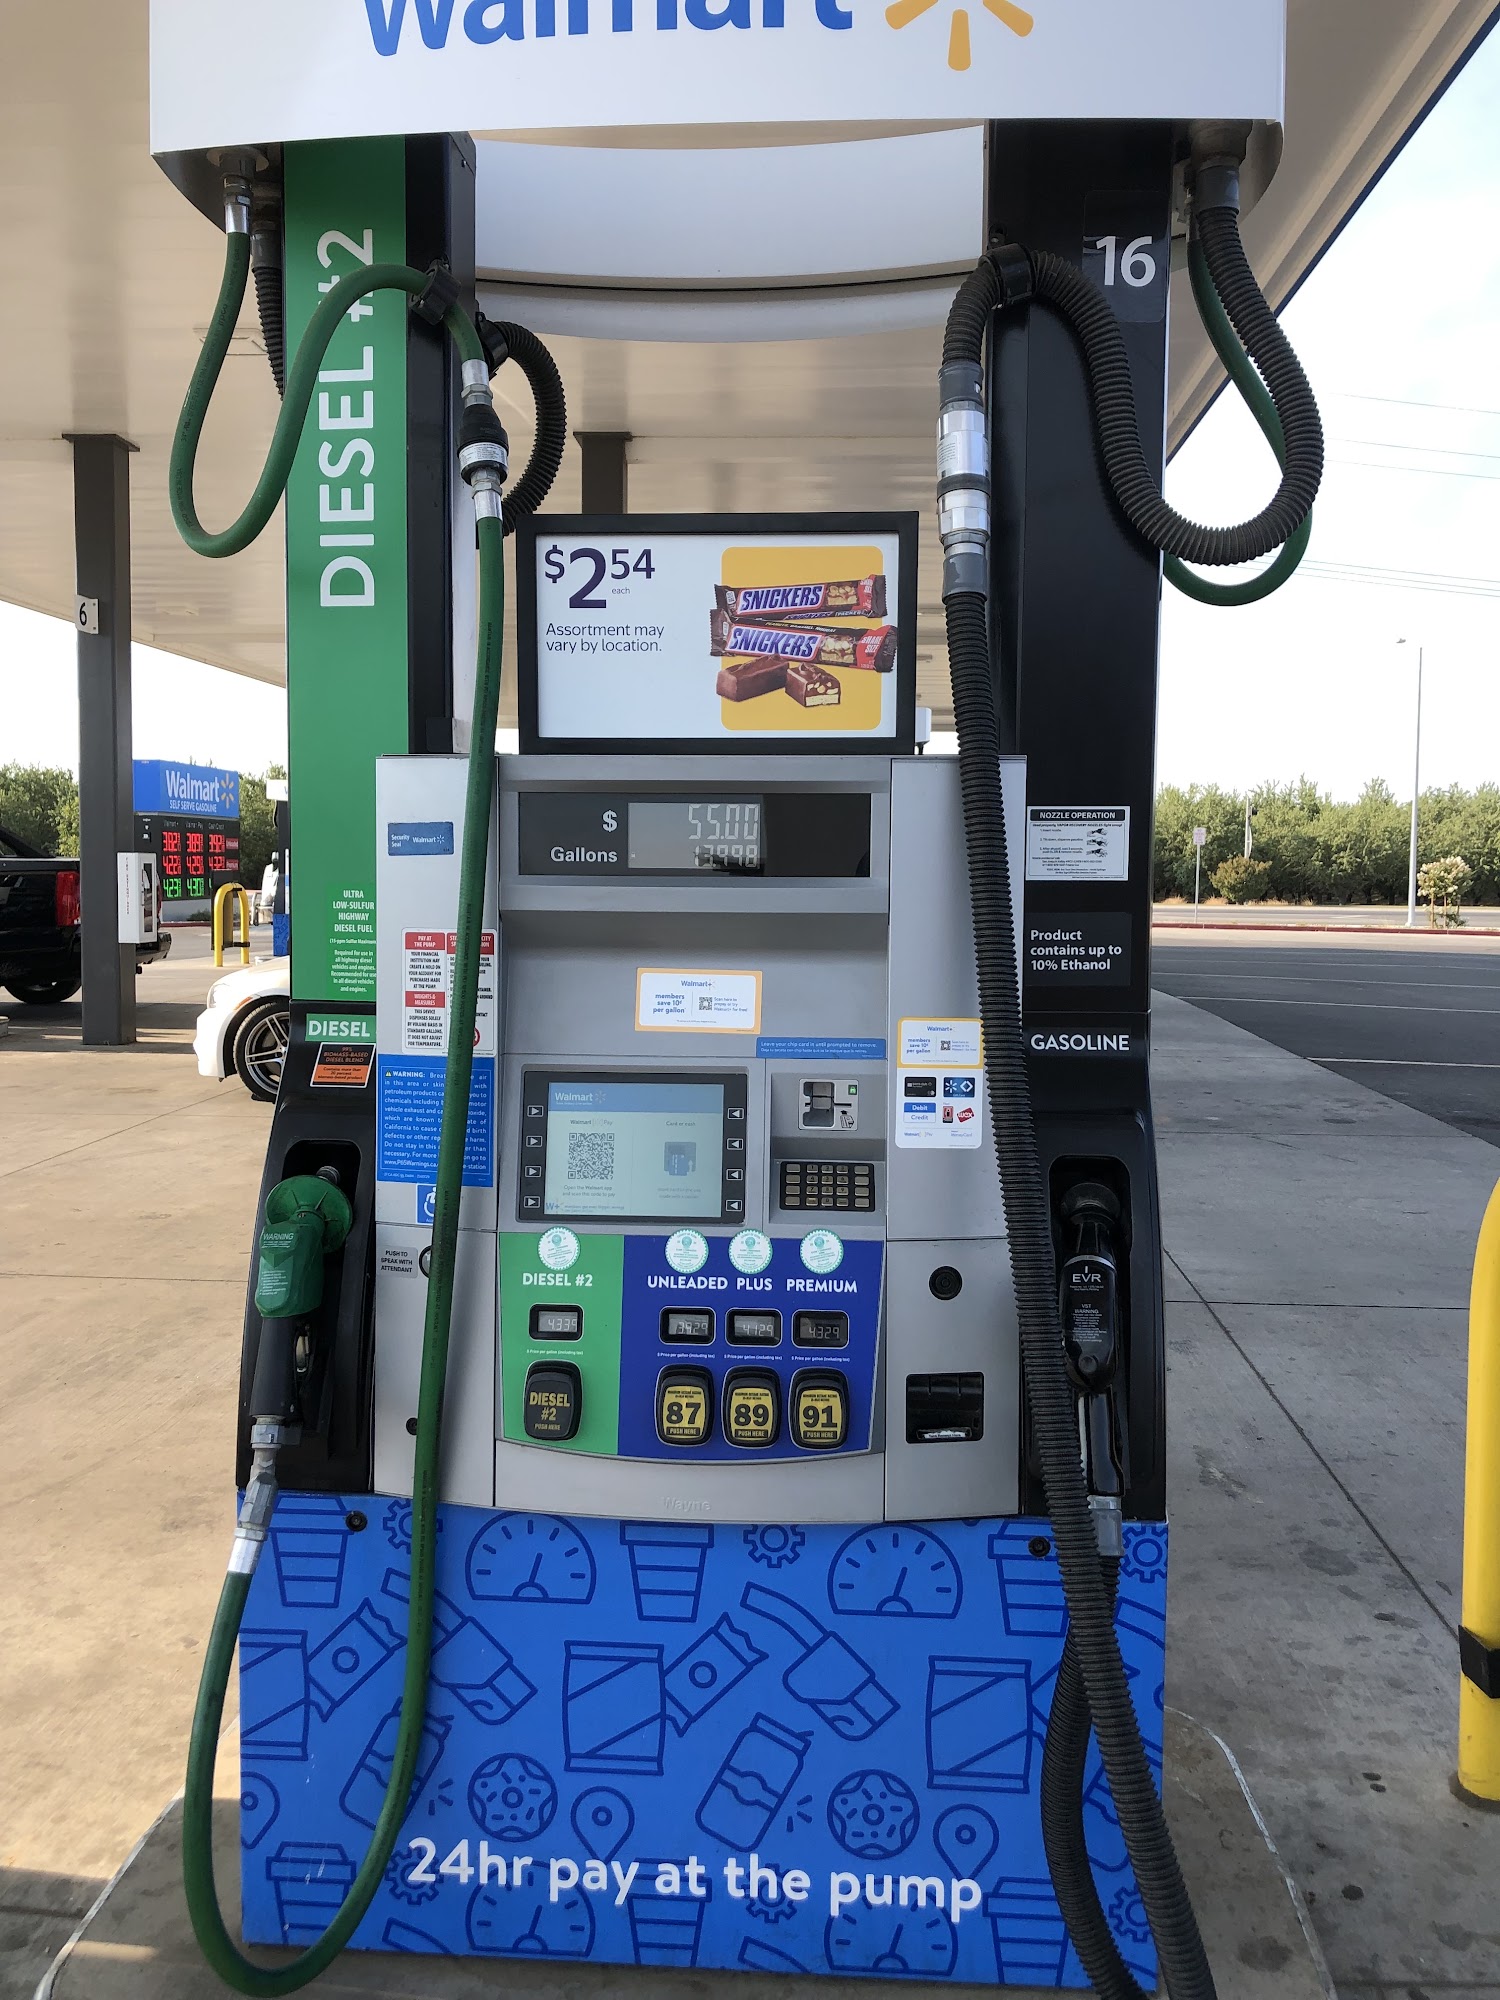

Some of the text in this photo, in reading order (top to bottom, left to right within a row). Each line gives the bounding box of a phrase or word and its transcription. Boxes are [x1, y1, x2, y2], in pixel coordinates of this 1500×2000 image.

[1095, 235, 1156, 287] 16
[318, 345, 375, 607] DIESEL
[611, 586, 631, 595] each
[740, 585, 824, 611] SNICKERS
[79, 601, 87, 626] 6
[546, 622, 665, 638] Assortment may
[546, 638, 662, 654] vary by location.
[729, 627, 822, 658] SNICKERS
[861, 635, 884, 645] SHARE
[166, 770, 220, 802] Walmart
[170, 799, 217, 813] SELF SERVE GASOLINE
[602, 803, 759, 840] $ 55.00
[1039, 811, 1070, 819] NOZZLE
[391, 834, 410, 842] Security
[550, 846, 618, 863] Gallons
[343, 889, 364, 898] ULTRA
[333, 901, 375, 910] LOW-SULFUR
[338, 912, 370, 921] HIGHWAY
[334, 923, 374, 933] DIESEL FUEL
[1030, 929, 1083, 941] Product
[1030, 944, 1122, 958] contains up to
[1031, 958, 1111, 971] 10% Ethanol
[308, 1020, 371, 1037] DIESEL
[1030, 1034, 1130, 1051] GASOLINE
[393, 1070, 426, 1078] WARNING:
[384, 1088, 412, 1097] petroleum
[412, 1089, 437, 1097] products
[555, 1092, 594, 1101] Walmart
[384, 1097, 412, 1105] chemicals
[413, 1098, 440, 1107] including
[384, 1123, 412, 1132] California
[384, 1132, 405, 1140] defects
[405, 1142, 417, 1150] stay
[263, 1232, 294, 1241] WARNING
[380, 1265, 413, 1273] ATTENDANT
[522, 1272, 593, 1288] DIESEL #2
[647, 1275, 858, 1293] UNLEADED PLUS PREMIUM
[1072, 1273, 1102, 1283] EVR
[529, 1391, 571, 1408] DIESEL
[540, 1407, 558, 1421] #2
[665, 1401, 702, 1425] 87
[733, 1403, 770, 1427] 89
[802, 1405, 838, 1429] 91
[663, 1496, 712, 1512] Wayne
[406, 1836, 983, 1923] 24hr pay at the pump
